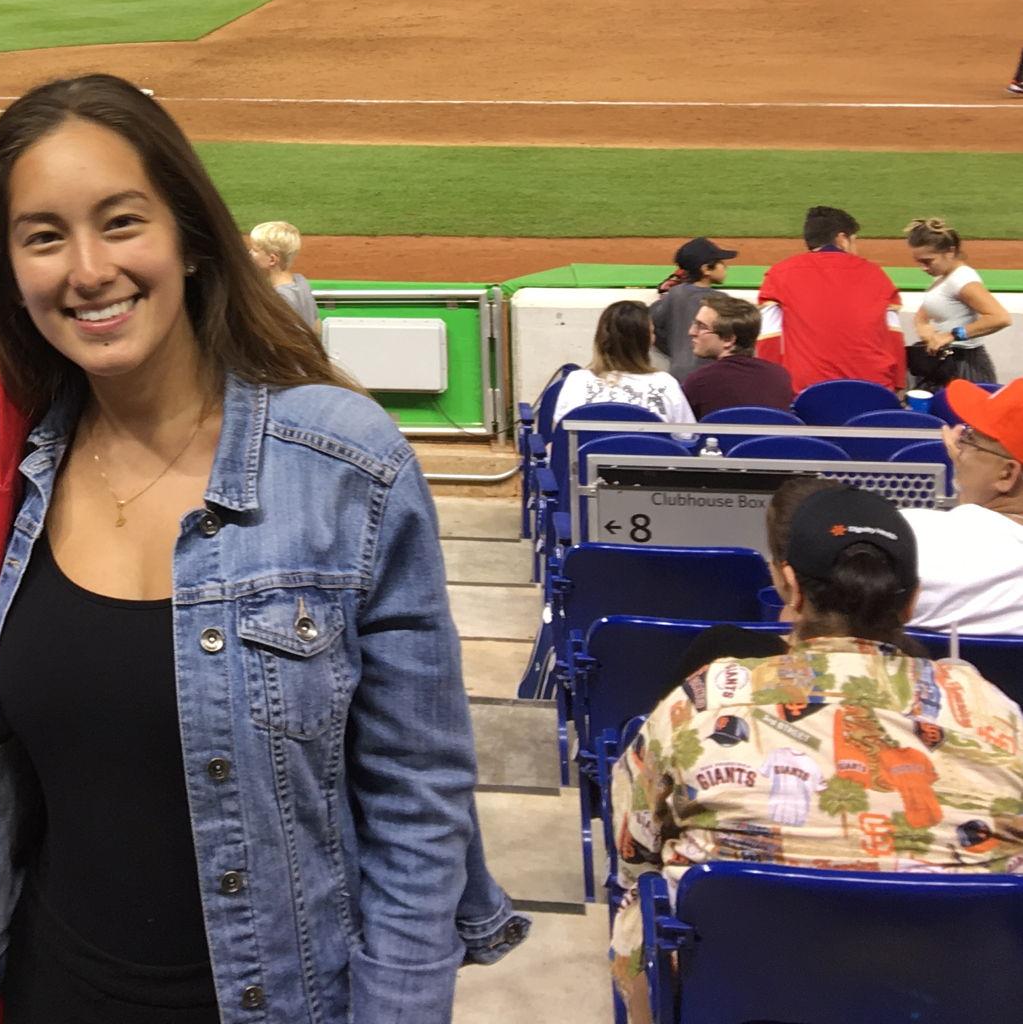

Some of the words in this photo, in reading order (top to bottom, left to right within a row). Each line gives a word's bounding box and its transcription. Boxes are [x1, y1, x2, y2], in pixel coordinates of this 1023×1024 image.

[651, 492, 734, 508] Clubhouse
[738, 495, 766, 509] Box
[629, 513, 652, 543] 8
[696, 767, 757, 791] GIANTS
[774, 765, 811, 782] GIANTS
